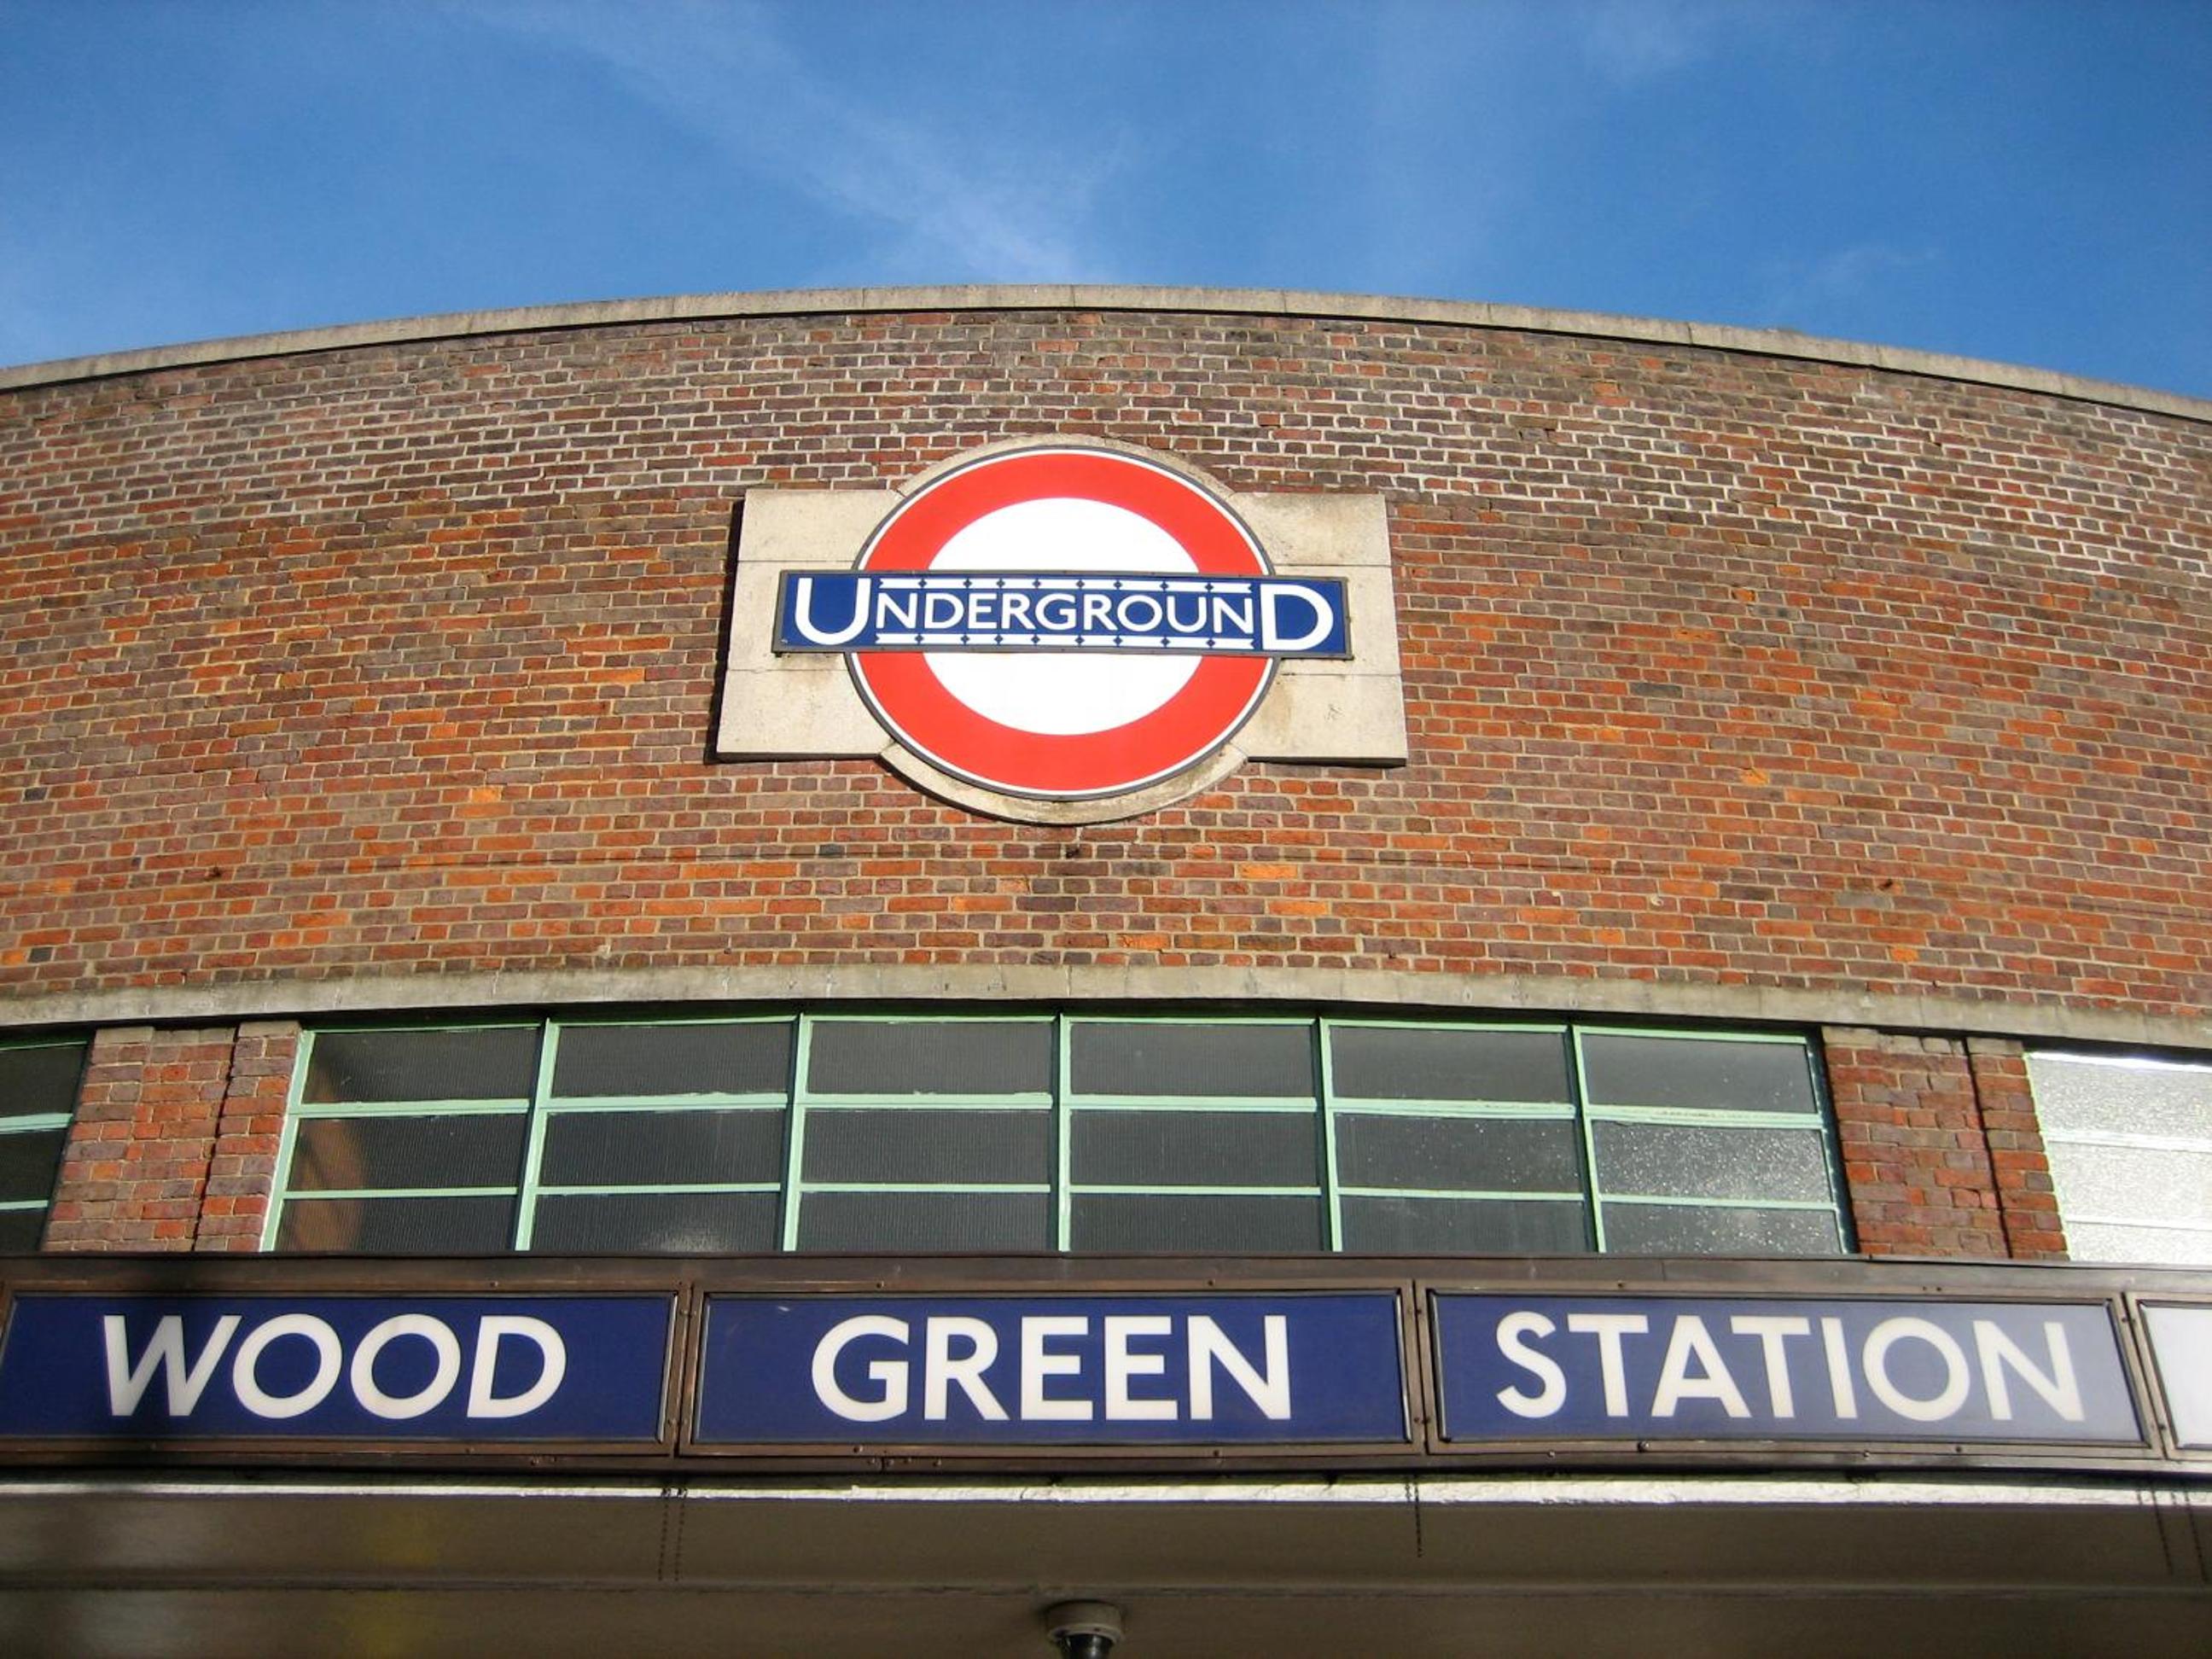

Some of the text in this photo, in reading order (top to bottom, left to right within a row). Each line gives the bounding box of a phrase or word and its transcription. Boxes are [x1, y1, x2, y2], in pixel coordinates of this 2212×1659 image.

[795, 577, 1335, 652] UNDERGROUND
[103, 1311, 2085, 1423] WOOD GREEN STATION
